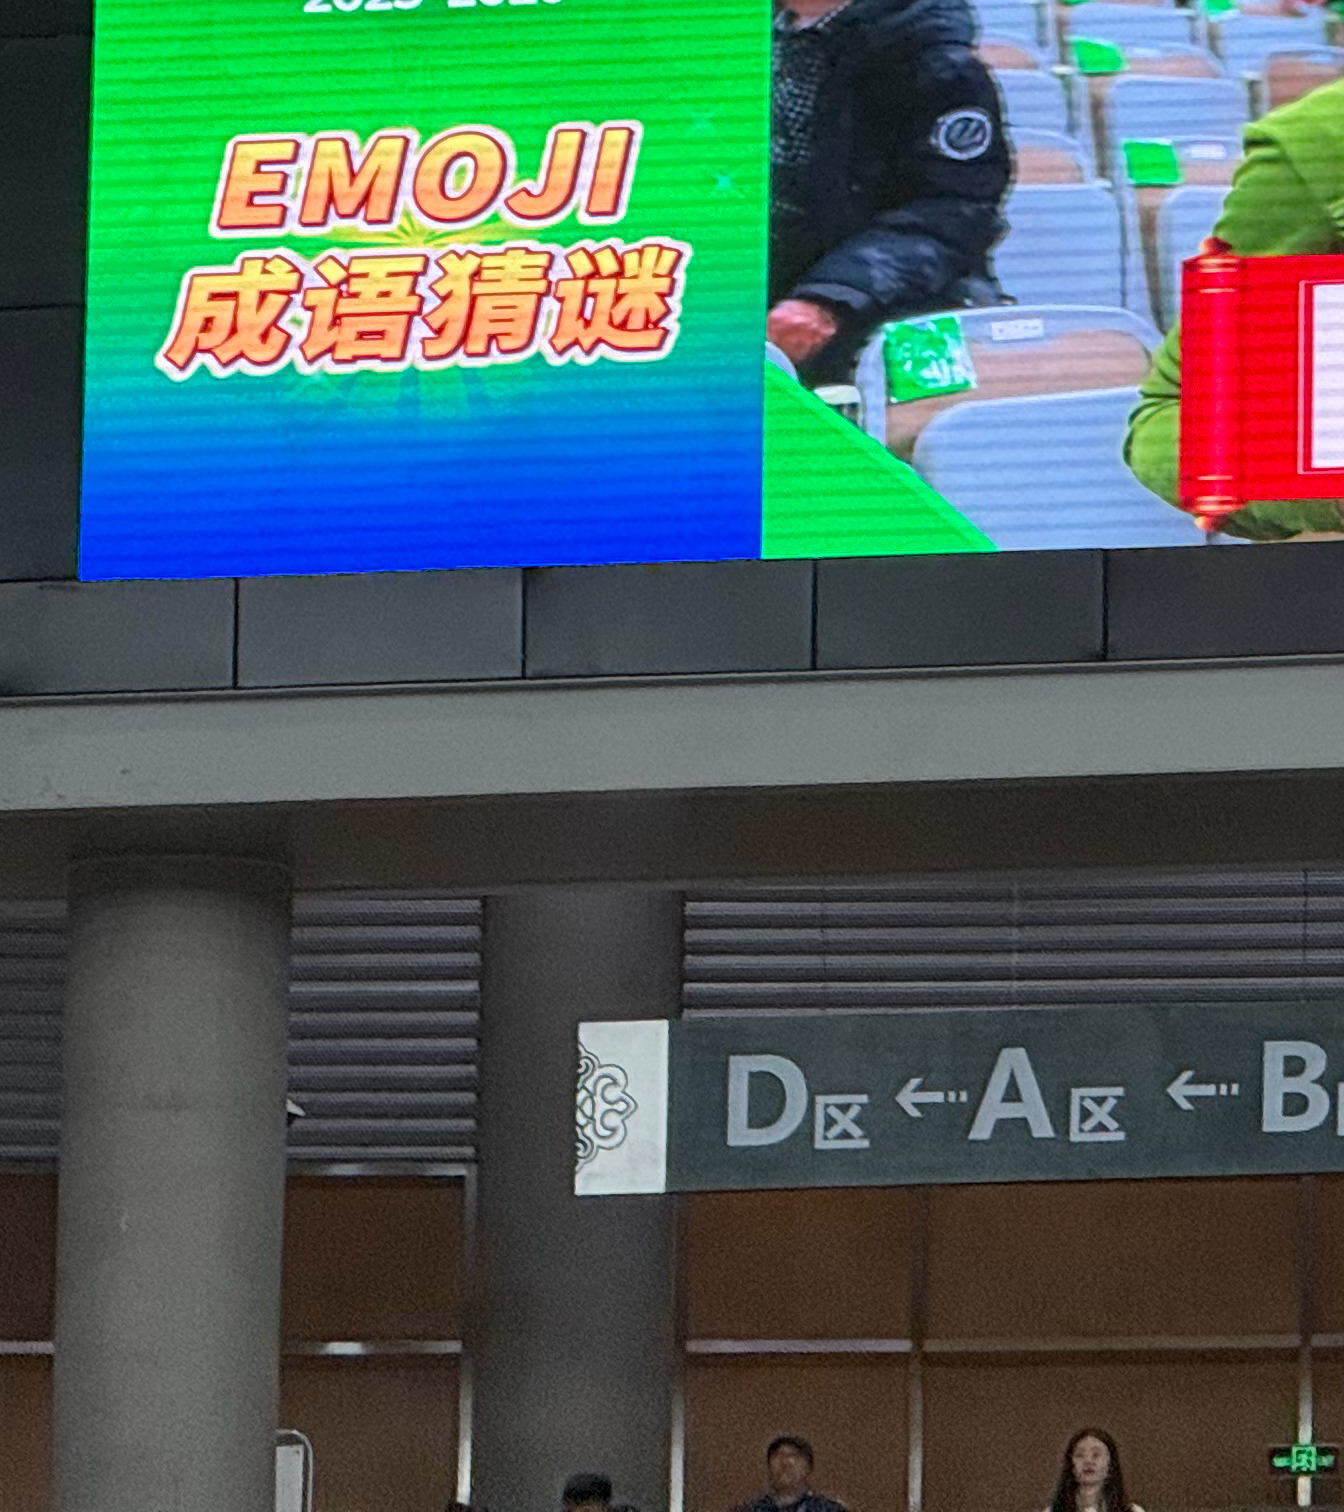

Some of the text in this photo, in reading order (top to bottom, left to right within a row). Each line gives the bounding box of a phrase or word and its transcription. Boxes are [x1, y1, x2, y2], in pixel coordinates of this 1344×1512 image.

[212, 122, 640, 236] EMOJI
[157, 240, 690, 379] 成语猜谜
[725, 1052, 871, 1151] D区
[967, 1046, 1125, 1143] A区
